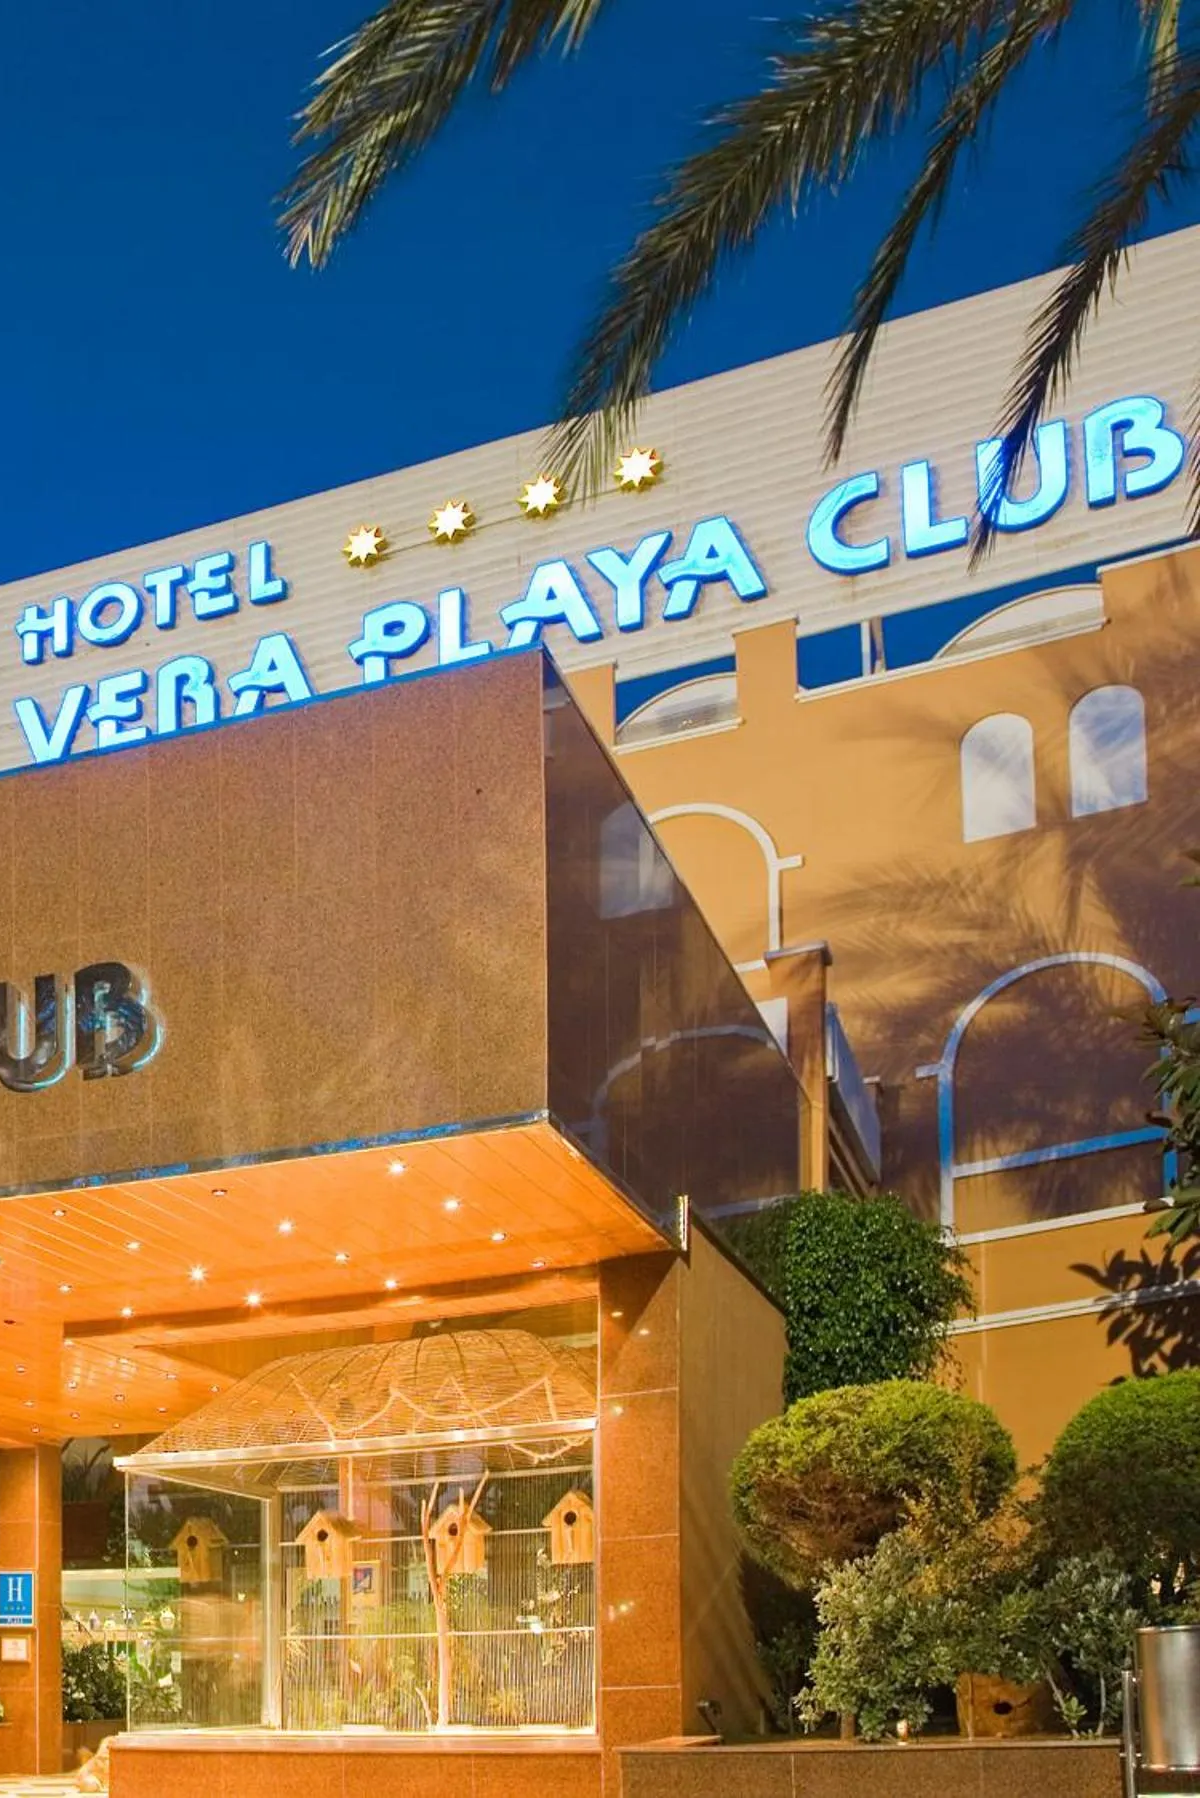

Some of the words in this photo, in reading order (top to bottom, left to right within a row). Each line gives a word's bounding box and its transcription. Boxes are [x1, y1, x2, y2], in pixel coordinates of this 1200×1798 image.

[14, 632, 315, 764] VERA
[348, 514, 768, 684] PLAYA
[806, 395, 1185, 576] CLUB
[15, 540, 289, 664] HOTEL
[7, 1577, 24, 1602] H
